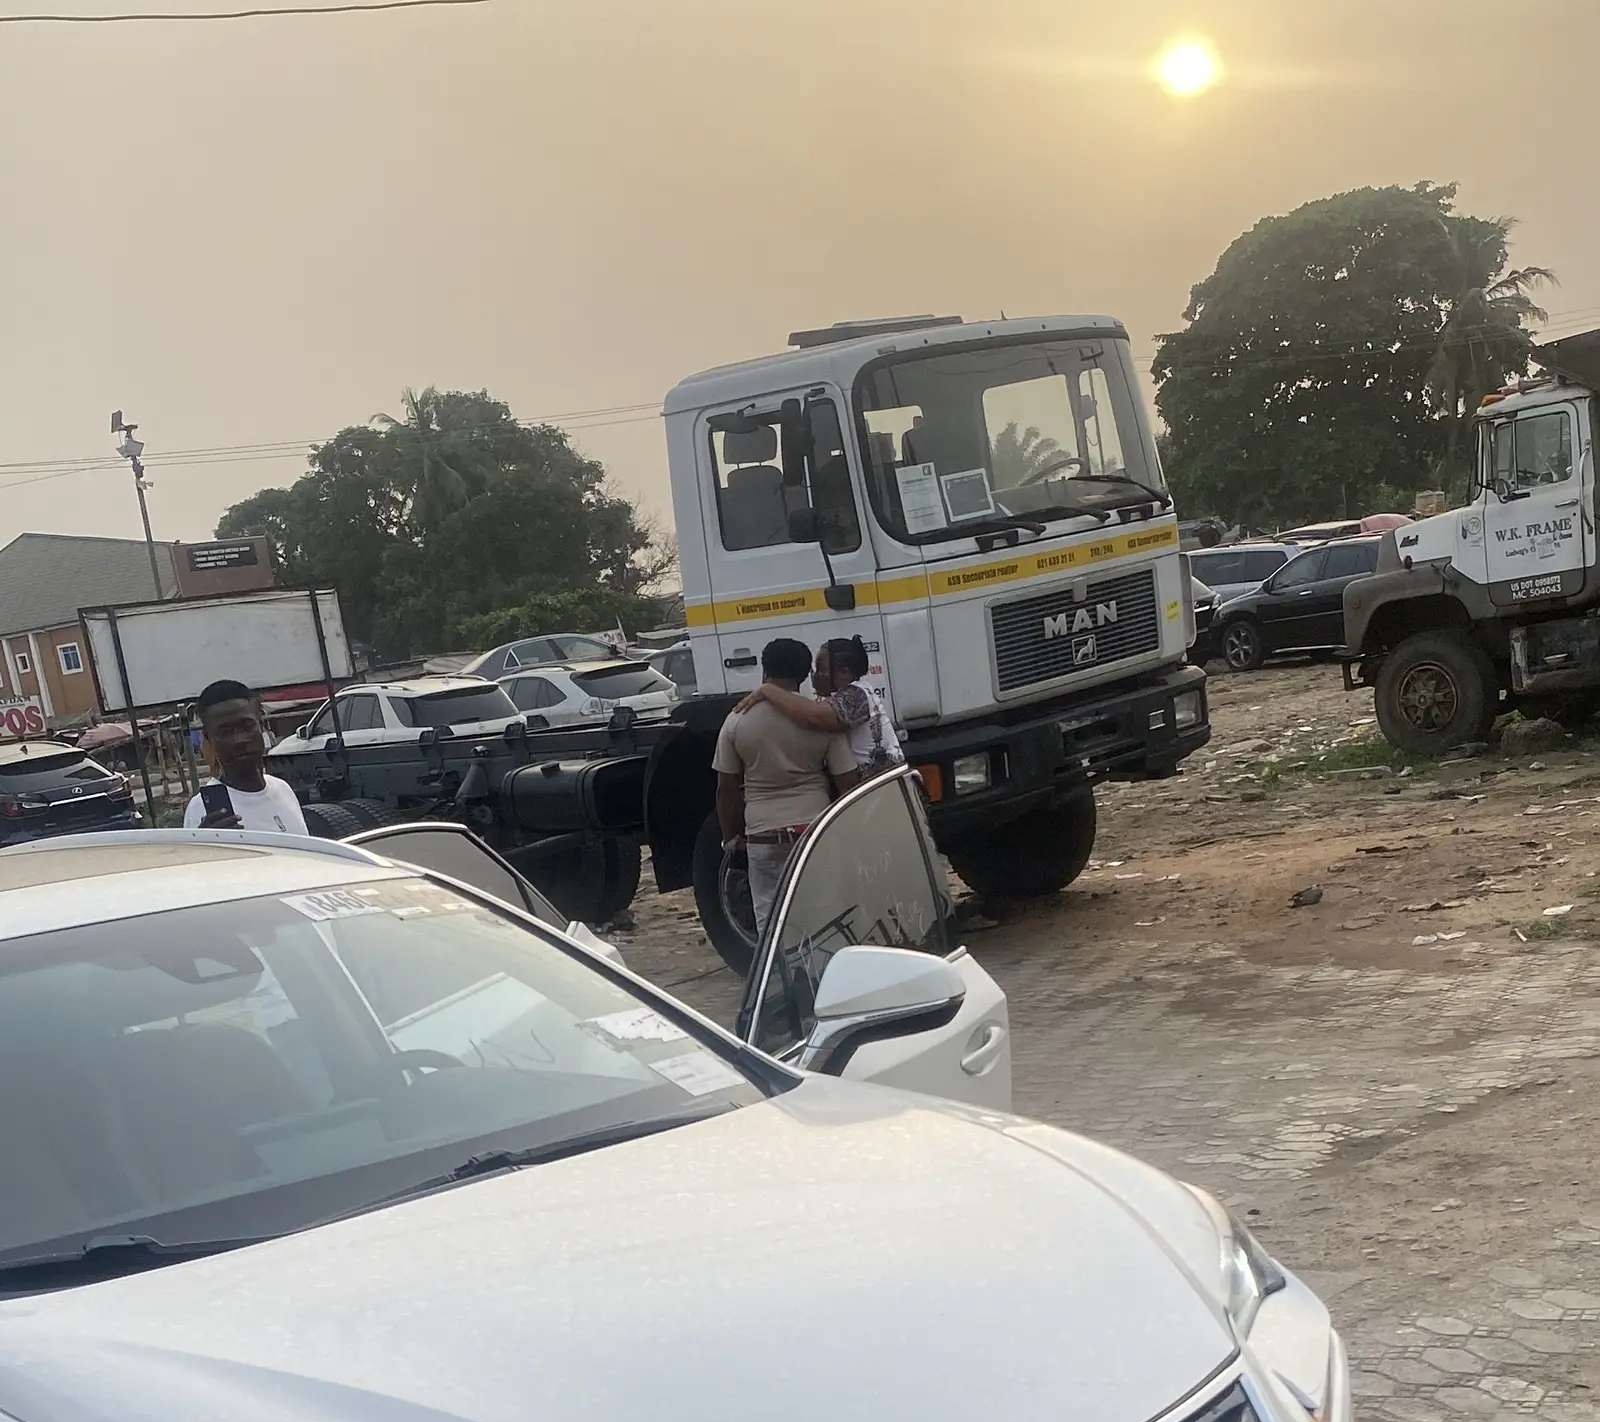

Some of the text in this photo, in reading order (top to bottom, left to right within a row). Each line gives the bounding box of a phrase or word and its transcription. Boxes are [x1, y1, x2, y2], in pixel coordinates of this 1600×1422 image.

[1495, 527, 1522, 542] W.K.
[1526, 518, 1572, 537] FRAME
[1512, 590, 1527, 600] MC
[1044, 601, 1118, 639] MAN
